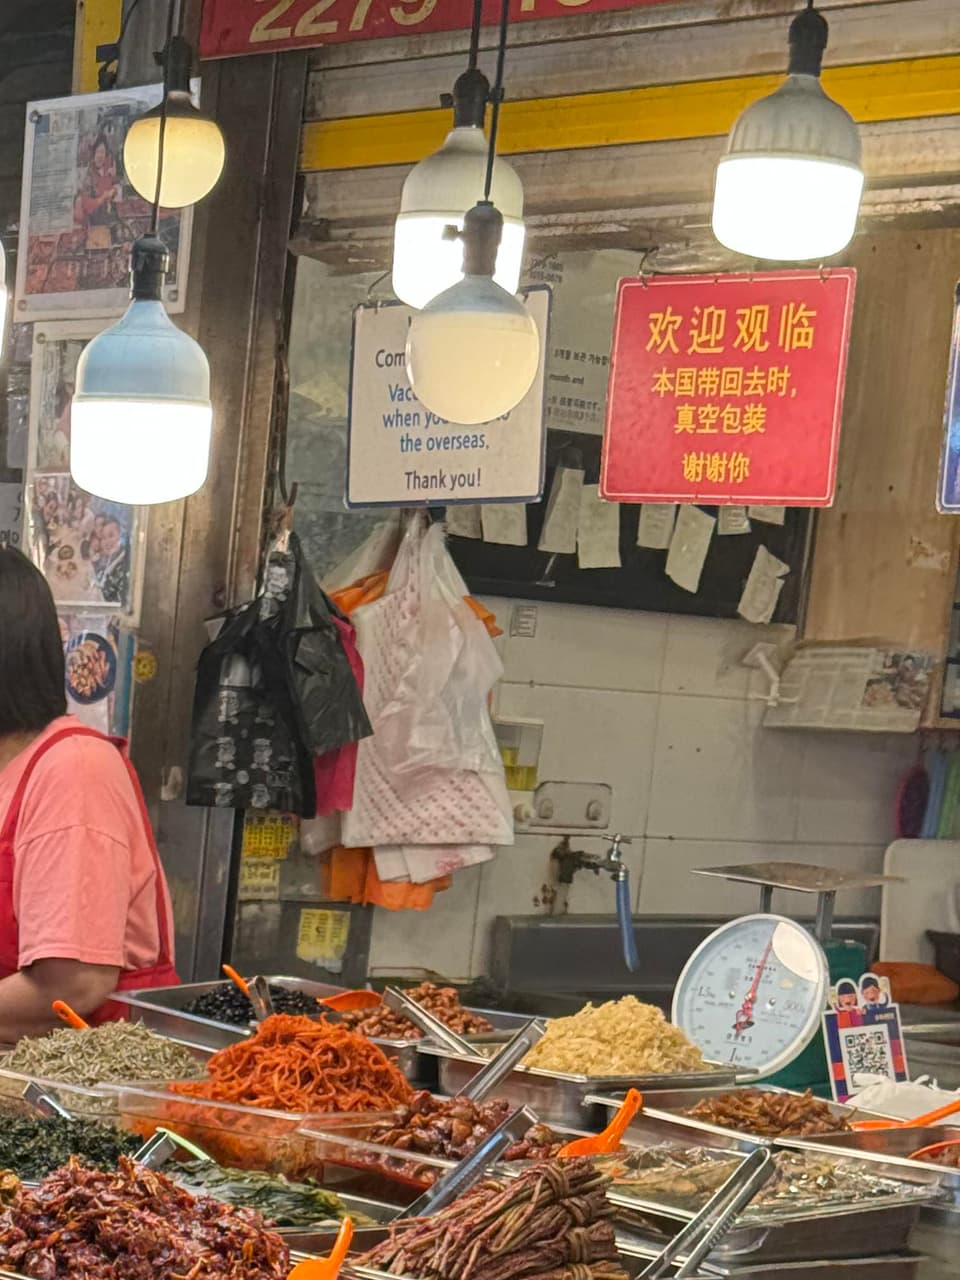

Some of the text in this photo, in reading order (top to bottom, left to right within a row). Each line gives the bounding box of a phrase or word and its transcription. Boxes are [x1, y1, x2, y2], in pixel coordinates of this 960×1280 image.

[645, 302, 817, 355] 欢迎观临
[382, 408, 420, 428] when
[674, 402, 767, 435] 真空包装
[400, 433, 421, 453] the
[405, 468, 481, 491] Thank you!
[682, 451, 750, 484] 谢谢你
